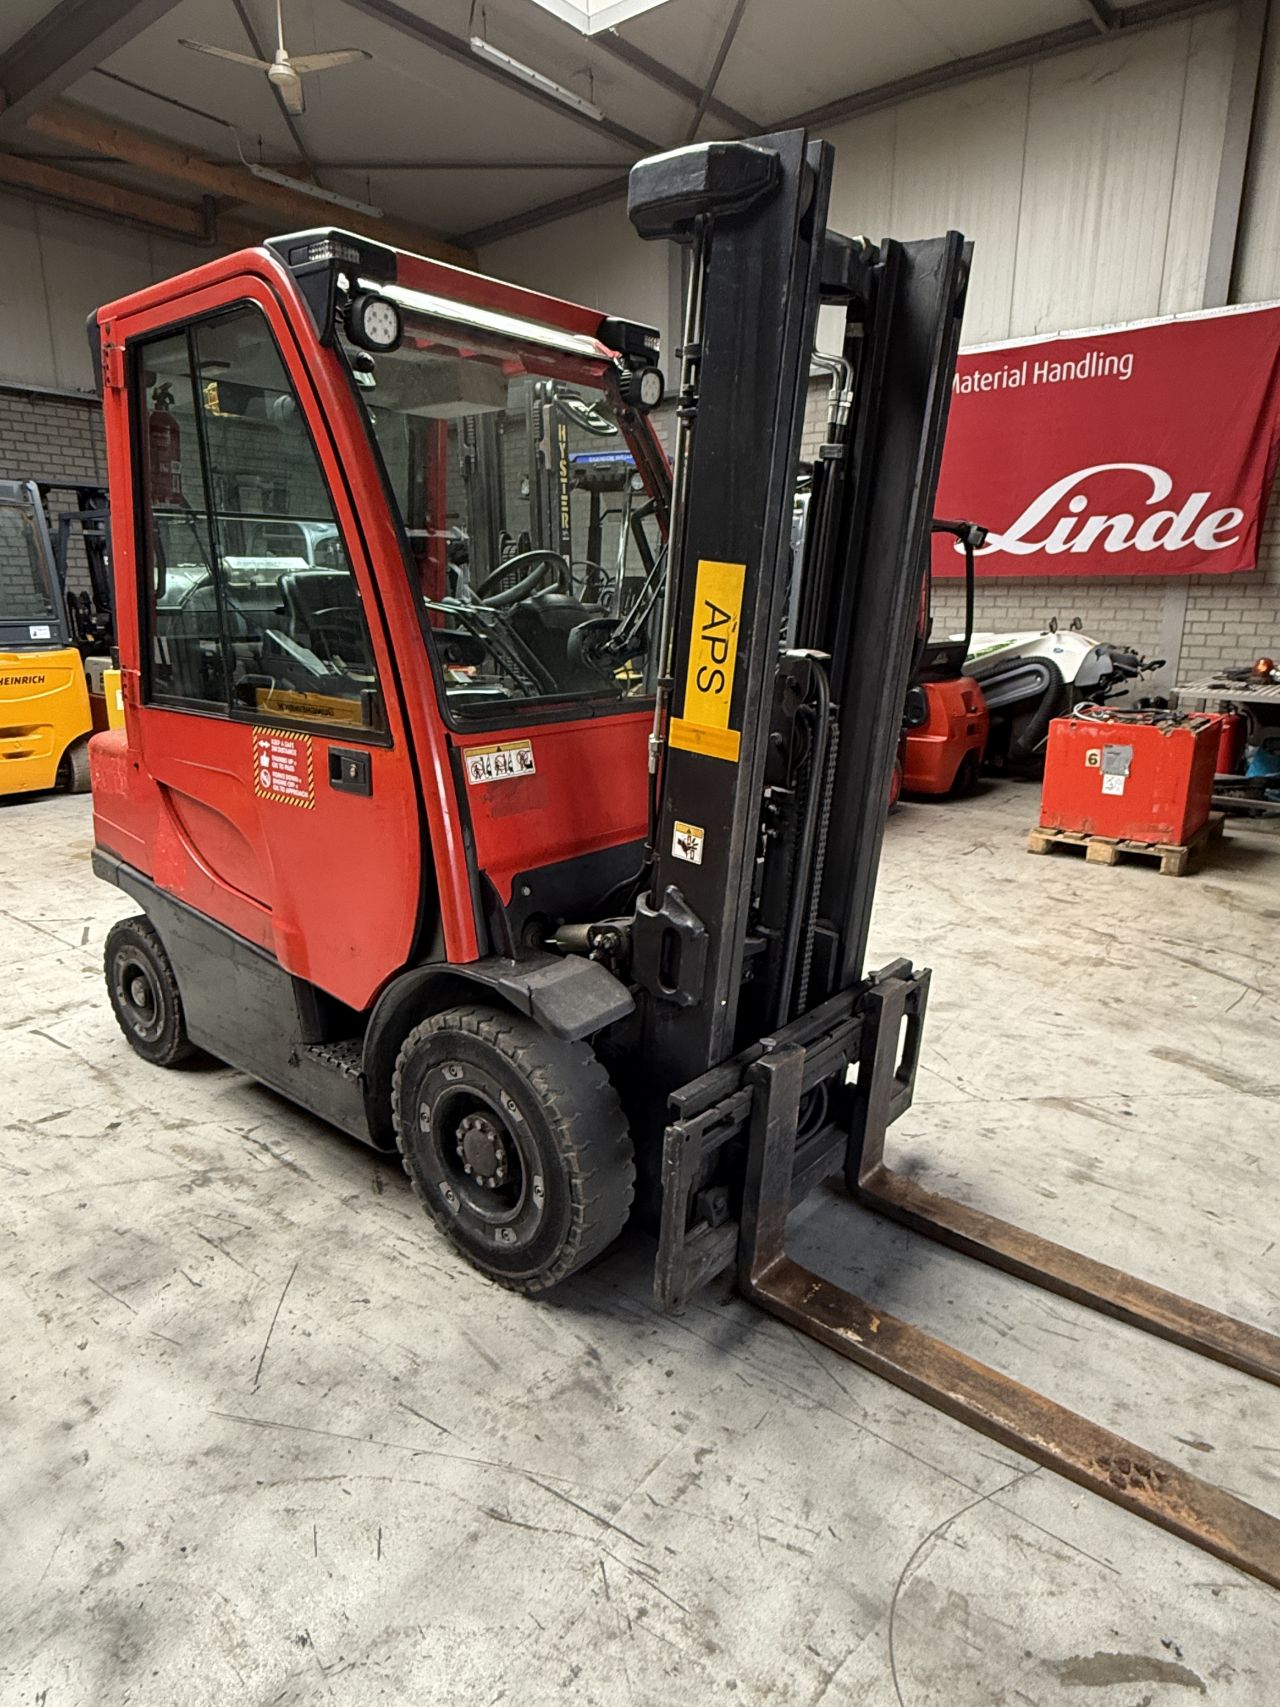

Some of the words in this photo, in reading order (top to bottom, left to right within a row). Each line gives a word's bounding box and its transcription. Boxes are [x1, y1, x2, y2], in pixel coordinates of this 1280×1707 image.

[1033, 351, 1134, 380] Handling
[558, 424, 569, 529] HYSTER
[953, 462, 1244, 556] Linde
[696, 600, 731, 694] APS
[1088, 753, 1098, 766] 6
